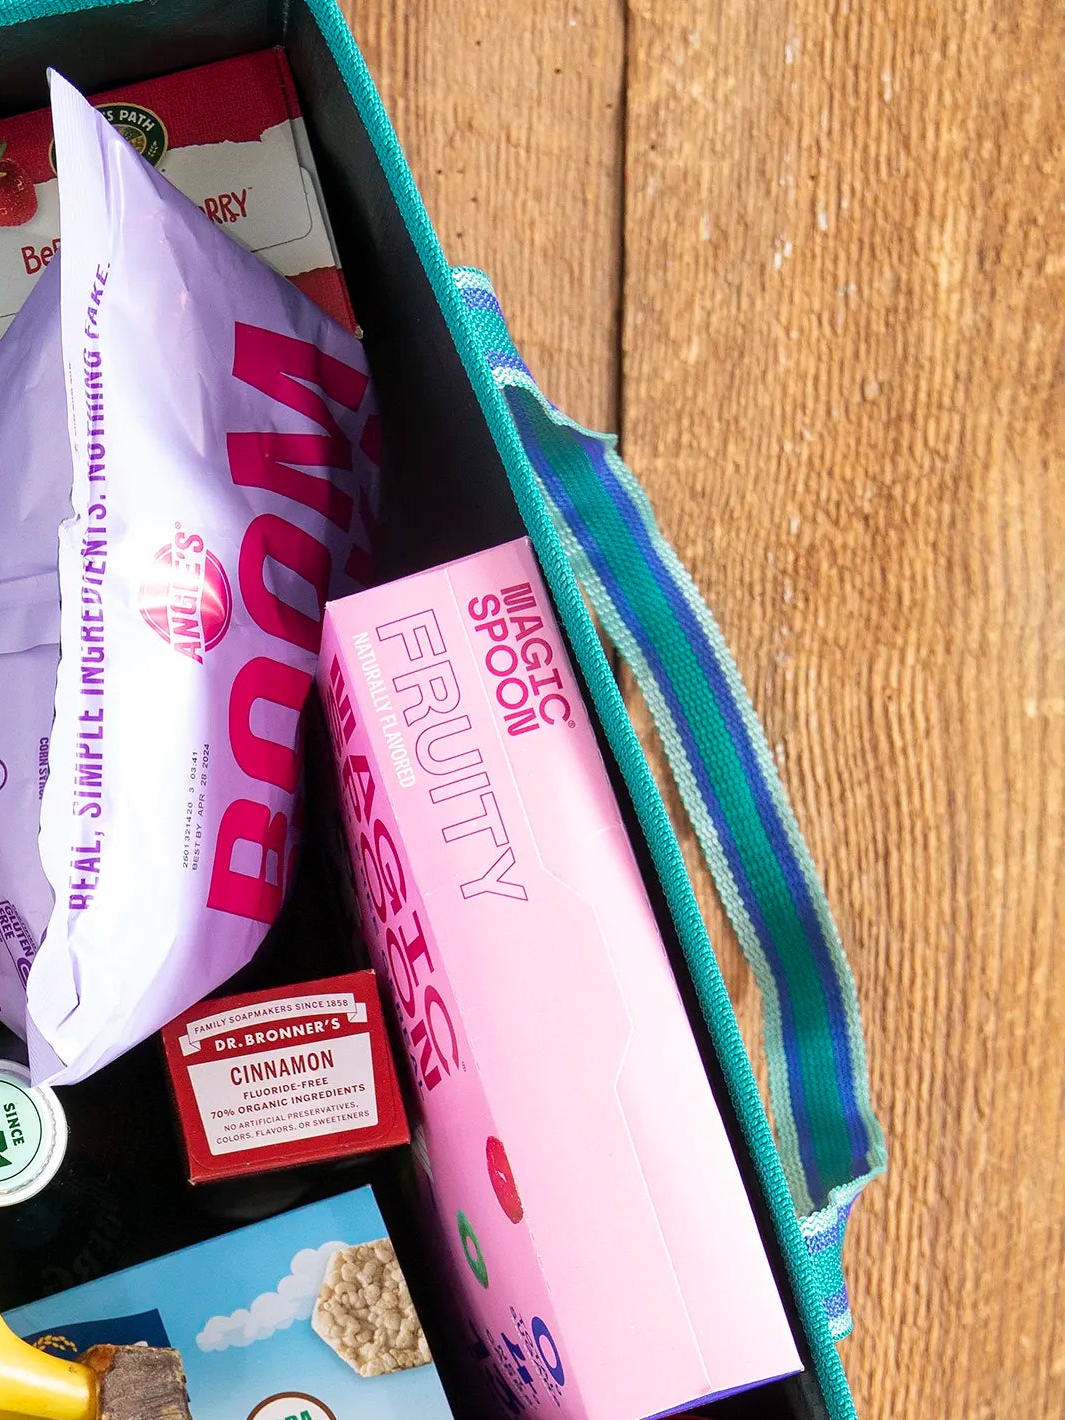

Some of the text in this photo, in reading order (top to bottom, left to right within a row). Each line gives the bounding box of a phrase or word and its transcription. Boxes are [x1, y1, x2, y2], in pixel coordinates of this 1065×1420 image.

[119, 109, 156, 132] PATH
[68, 262, 112, 910] REAL, SIMPLE INGREDIENTS. NOTHING FAKE.
[170, 532, 204, 665] ANGIE'S
[207, 321, 368, 926] BOOM
[467, 595, 541, 737] SPOON
[499, 581, 564, 726] MAGIC
[352, 630, 395, 714] NATURALLY
[378, 711, 417, 789] FLAVORED
[38, 736, 49, 766] CORN
[189, 751, 198, 780] 03:41
[375, 608, 529, 902] FRUITY
[191, 743, 210, 871] BEST BY APR 28 2024
[326, 683, 442, 1092] SPOON
[330, 653, 460, 1078] MAGIC
[4, 904, 35, 958] GLUTEN
[194, 999, 349, 1035] FAMILY SOAPMAKERS SINCE 1858
[230, 1049, 335, 1086] CINNAMON
[243, 1077, 329, 1100] FLUORIDE-FREE
[2, 1101, 26, 1148] SINCE
[210, 1083, 366, 1120] 70% ORGANIC INGREDIENTS
[216, 1109, 370, 1145] COLORS, FLAVORS, OR SWEETENERS
[223, 1101, 359, 1132] NO ARTIFICIAL PRESERVATIVES,
